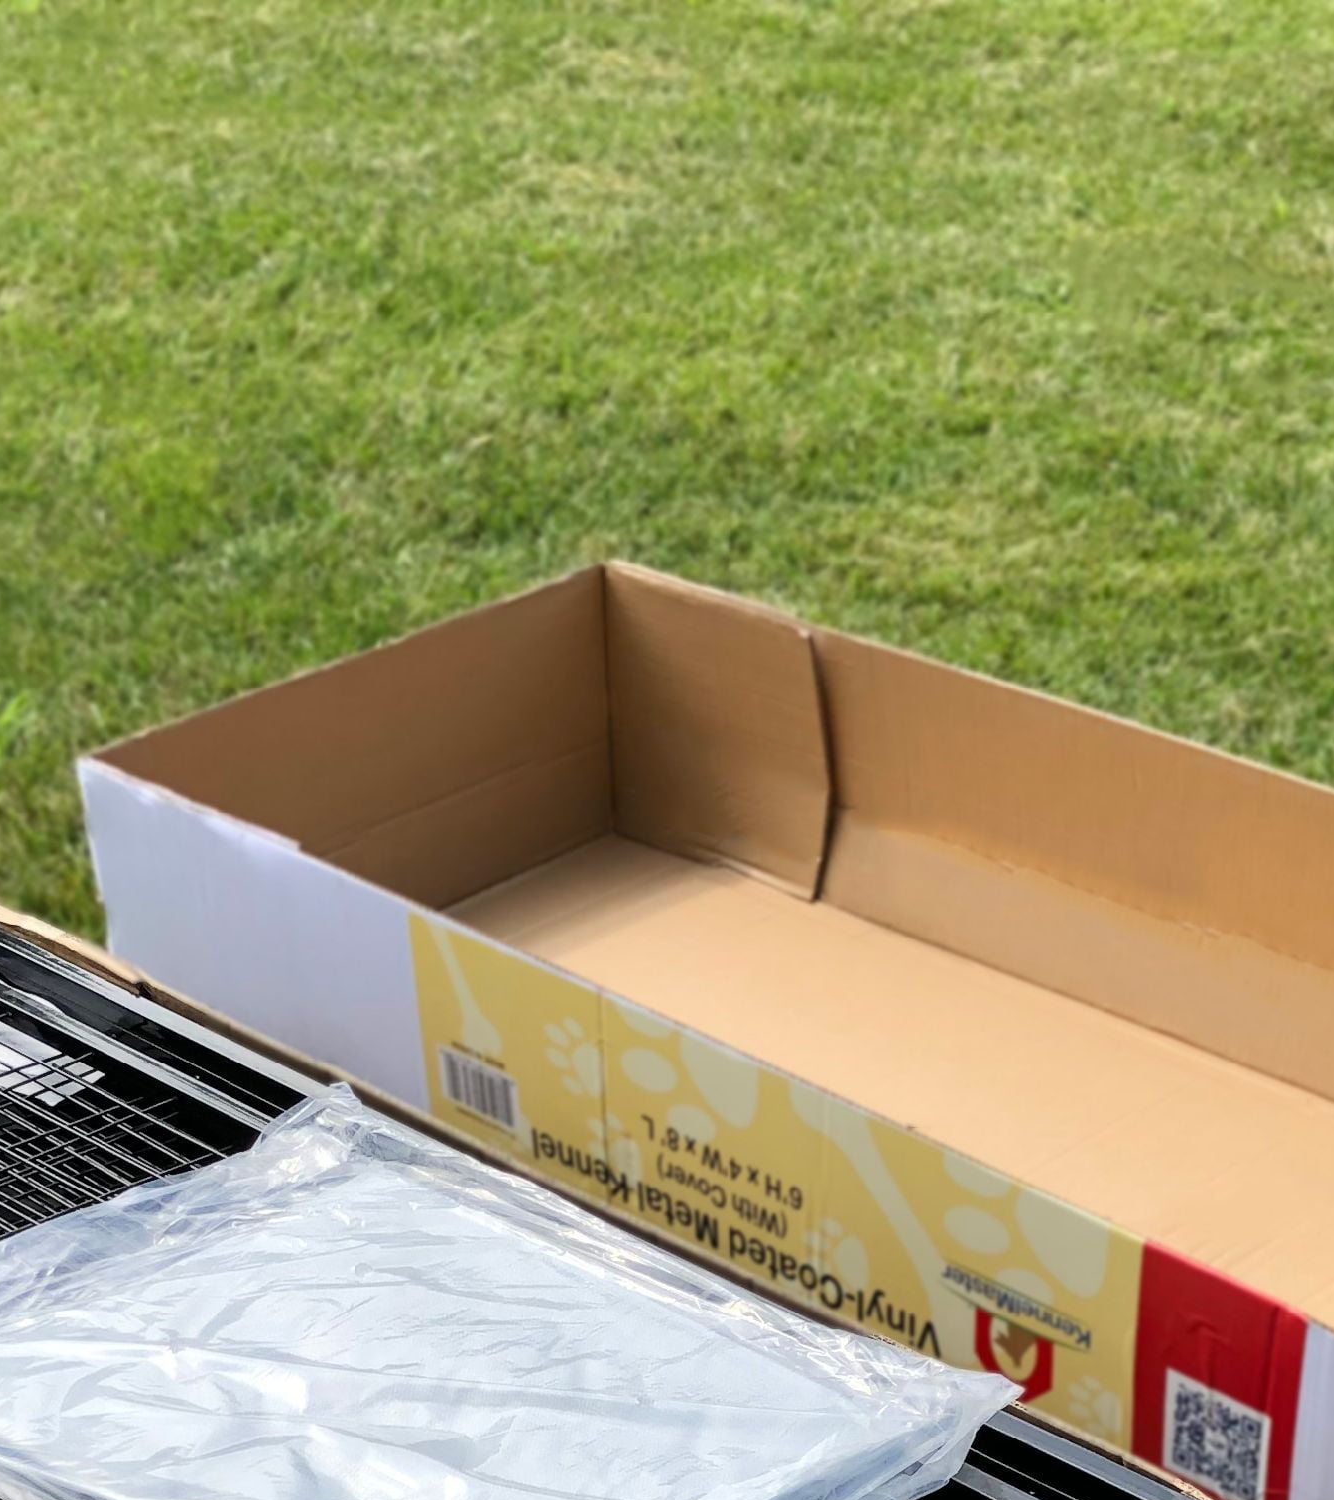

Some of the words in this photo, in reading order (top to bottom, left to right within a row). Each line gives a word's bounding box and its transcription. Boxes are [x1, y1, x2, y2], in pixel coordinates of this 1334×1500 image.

[640, 1113, 655, 1141] L
[684, 1135, 697, 1156] x
[531, 1127, 629, 1200] Kennel
[656, 1152, 727, 1209] Cover)
[747, 1165, 759, 1186] x
[637, 1181, 720, 1250] Metal
[731, 1193, 788, 1239] (With
[730, 1226, 942, 1359] Vinyl-Coated
[940, 1264, 1092, 1349] KennelMaster
